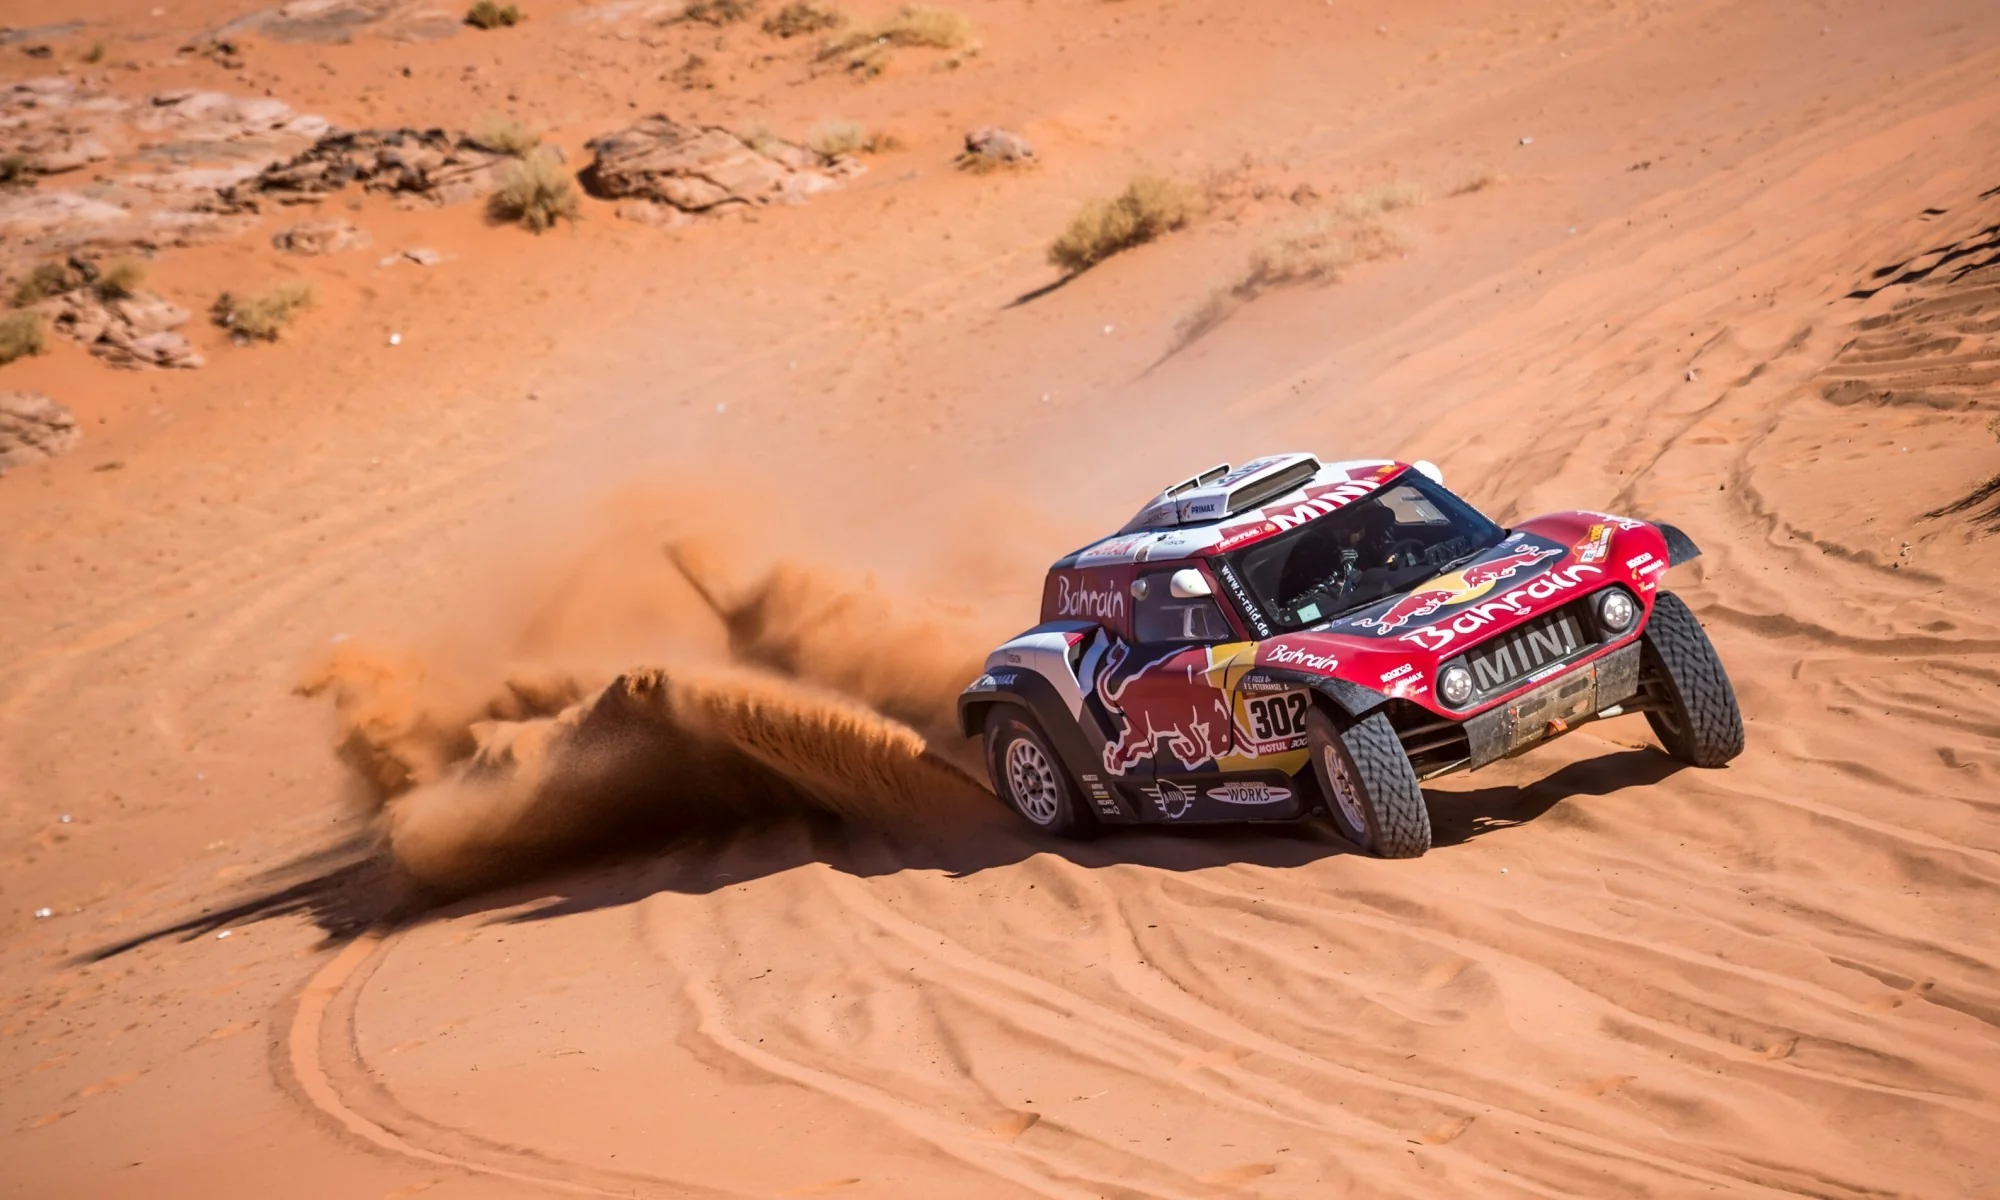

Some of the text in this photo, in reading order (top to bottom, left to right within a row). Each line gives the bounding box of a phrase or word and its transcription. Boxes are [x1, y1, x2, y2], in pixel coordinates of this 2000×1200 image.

[1191, 504, 1215, 515] PRIMAX
[1268, 480, 1381, 532] MINI
[1219, 527, 1261, 550] MOTUL
[1058, 575, 1124, 618] Bahrain
[1221, 565, 1269, 637] www.x-raid.de
[1399, 564, 1602, 651] Bahrain
[1266, 644, 1338, 672] Bahrain
[1472, 618, 1577, 690] MINI
[1250, 693, 1307, 739] 302
[1259, 742, 1288, 754] MOTUL
[1227, 787, 1270, 801] WORKS
